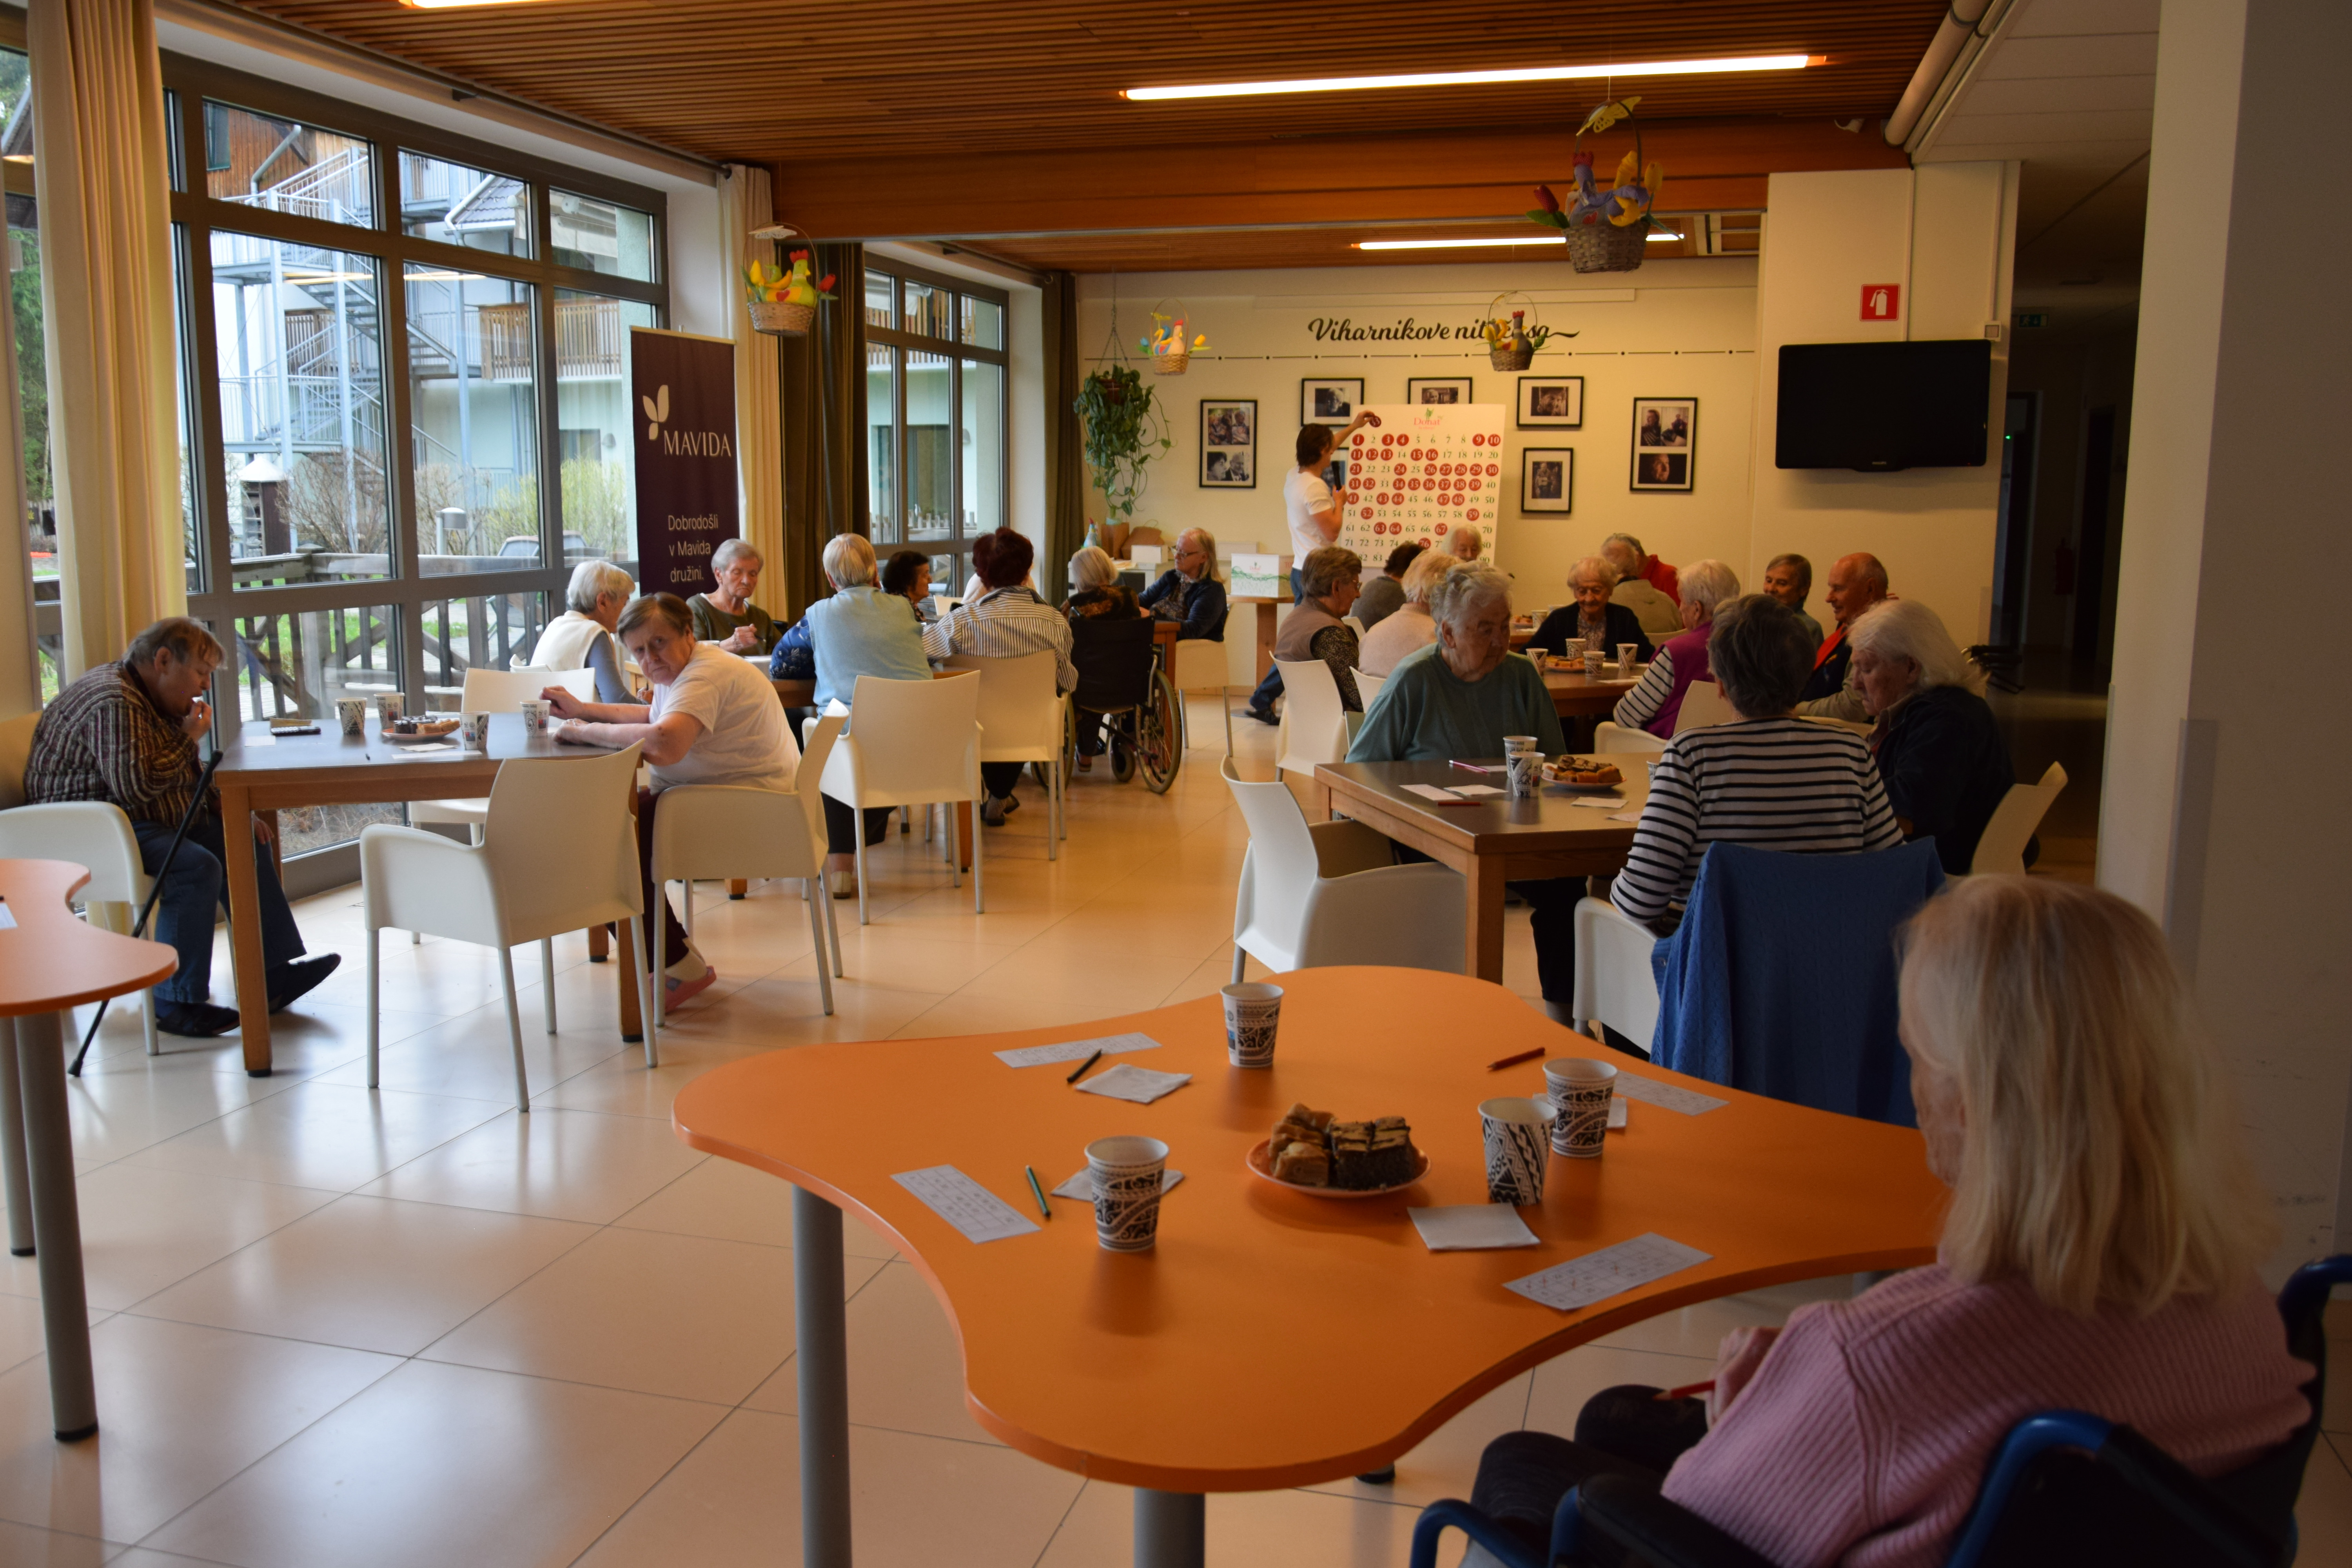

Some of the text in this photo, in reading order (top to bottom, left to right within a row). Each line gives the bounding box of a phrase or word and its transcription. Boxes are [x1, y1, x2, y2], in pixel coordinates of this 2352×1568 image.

[1308, 318, 1450, 341] Viharnikove
[1455, 318, 1489, 339] nit
[1414, 417, 1440, 425] Donat
[664, 430, 731, 457] MAVIDA
[1356, 436, 1360, 444] 1
[1441, 465, 1450, 473] 27
[668, 514, 718, 530] Dobrodošli
[669, 540, 711, 556] v Mavida
[670, 565, 704, 583] družini.
